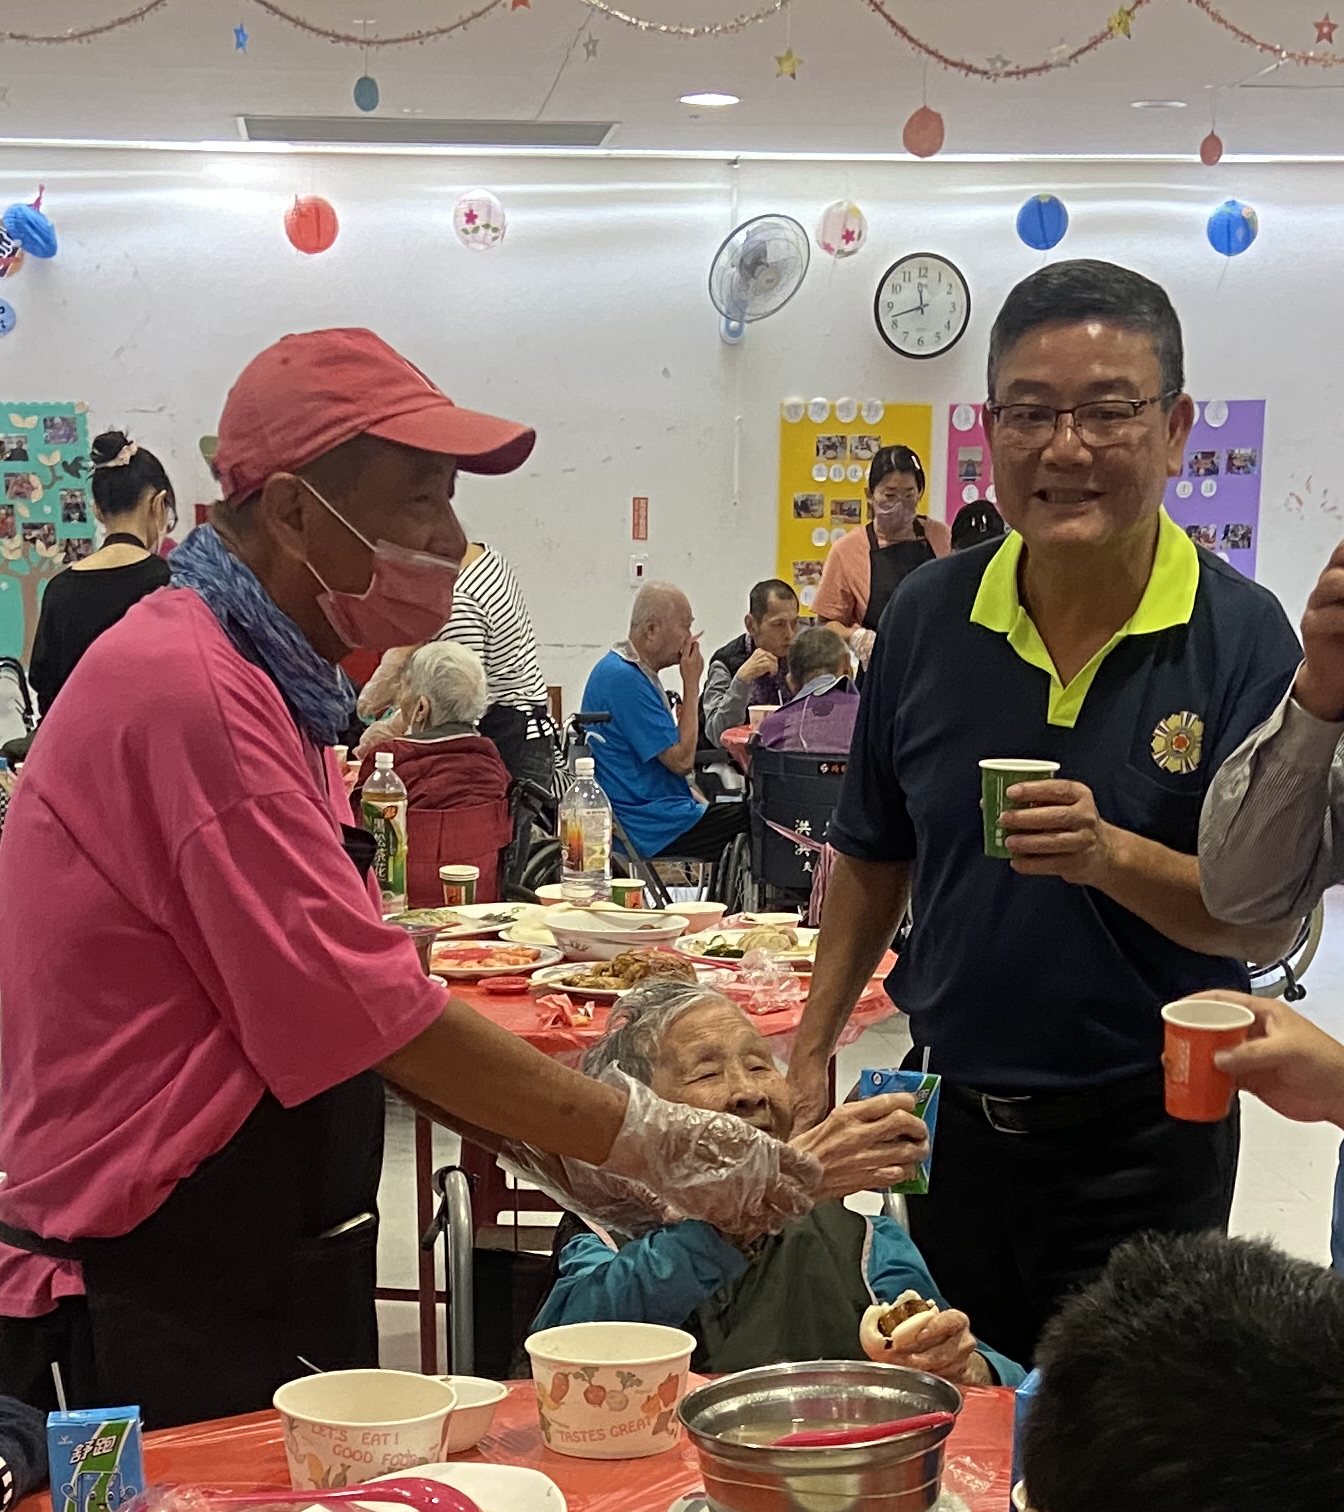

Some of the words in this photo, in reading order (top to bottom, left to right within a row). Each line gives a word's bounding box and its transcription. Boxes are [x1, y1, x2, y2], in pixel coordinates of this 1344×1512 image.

[902, 271, 911, 282] 11
[918, 267, 929, 278] 12
[937, 271, 942, 283] 1
[891, 283, 902, 294] 10
[946, 283, 953, 295] 2
[887, 301, 894, 312] 9
[950, 302, 956, 313] 3
[891, 320, 898, 329] 8
[944, 320, 951, 331] 4
[902, 331, 909, 342] 7
[917, 336, 925, 346] 6
[935, 331, 941, 341] 5
[310, 1423, 348, 1443] LET'S
[558, 1428, 606, 1443] TASTES
[69, 1435, 117, 1465] 舒跑
[332, 1443, 373, 1464] GOOD
[381, 1453, 418, 1467] FOOD
